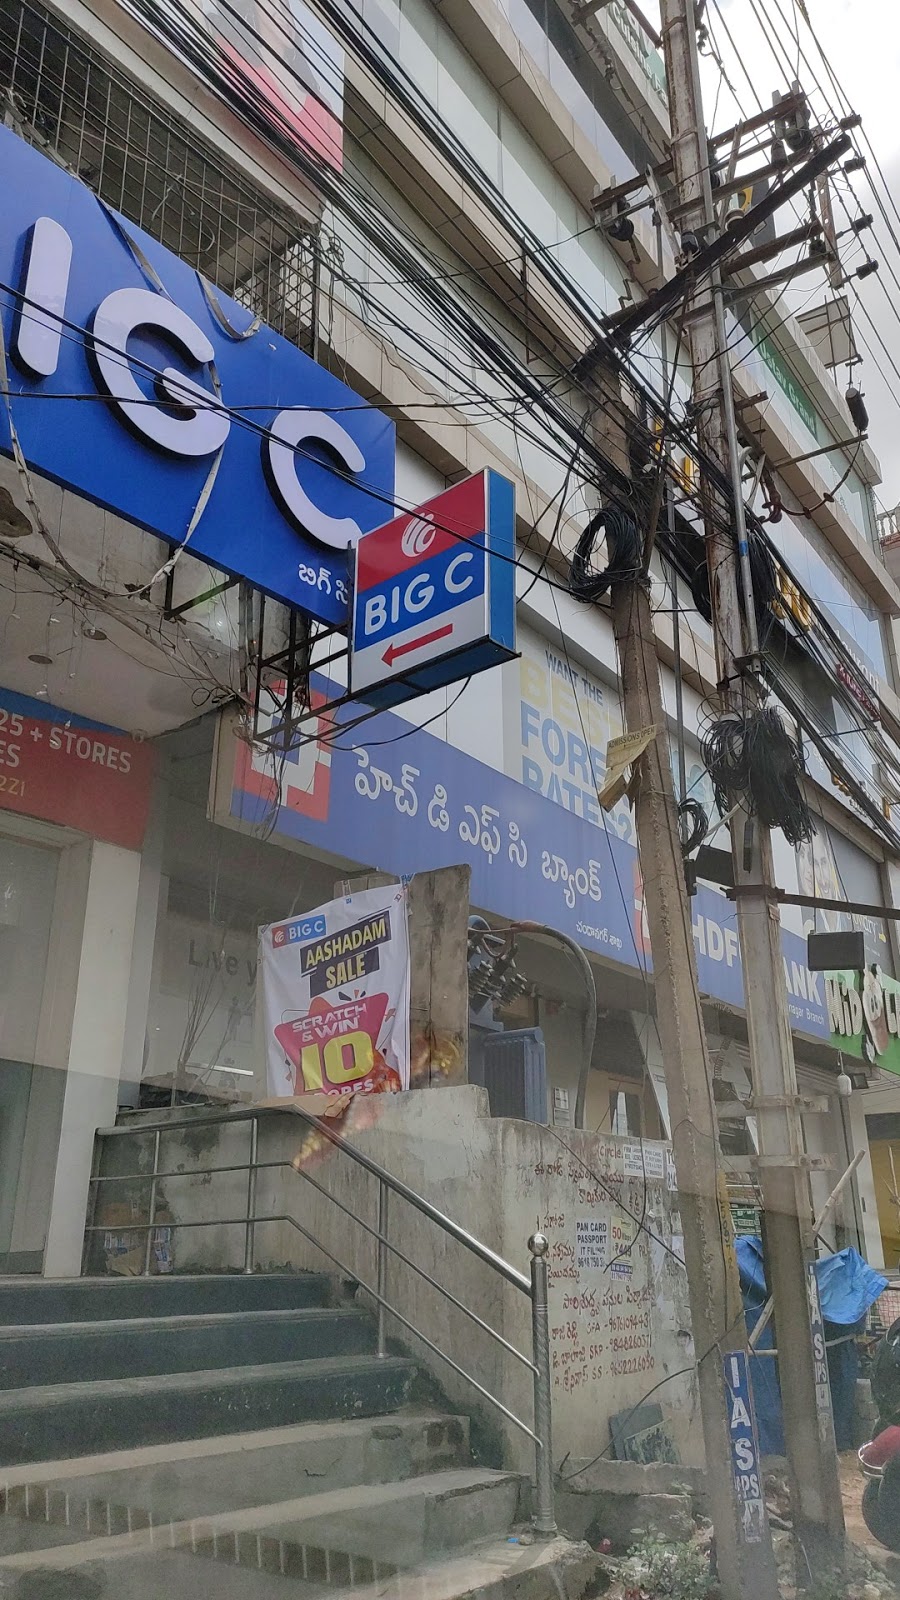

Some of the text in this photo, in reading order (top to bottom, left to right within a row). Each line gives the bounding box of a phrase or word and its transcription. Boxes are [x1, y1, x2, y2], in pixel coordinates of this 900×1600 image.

[788, 382, 817, 426] Grand
[262, 405, 366, 550] C
[299, 563, 331, 594] బిగ్
[365, 552, 473, 636] BIG C
[545, 650, 604, 706] WANT THE
[30, 727, 43, 742] +
[49, 727, 131, 773] STORES
[521, 700, 608, 793] FORE
[427, 784, 450, 832] డి
[459, 804, 500, 864] ఎఫ్
[508, 822, 527, 868] సి
[542, 850, 602, 909] బ్యాంక్
[289, 919, 324, 940] BIG C
[305, 918, 386, 969] AASHADAM
[326, 953, 366, 990] SALE
[692, 914, 822, 1007] HDF ANK
[293, 1003, 367, 1033] SCRATCH
[302, 1016, 359, 1041] & WIN
[806, 1008, 824, 1026] Branch
[302, 1031, 374, 1090] 10
[577, 1222, 607, 1232] PAN CARD
[577, 1235, 607, 1244] PASSPORT
[612, 1226, 622, 1240] 50
[580, 1246, 586, 1256] IT
